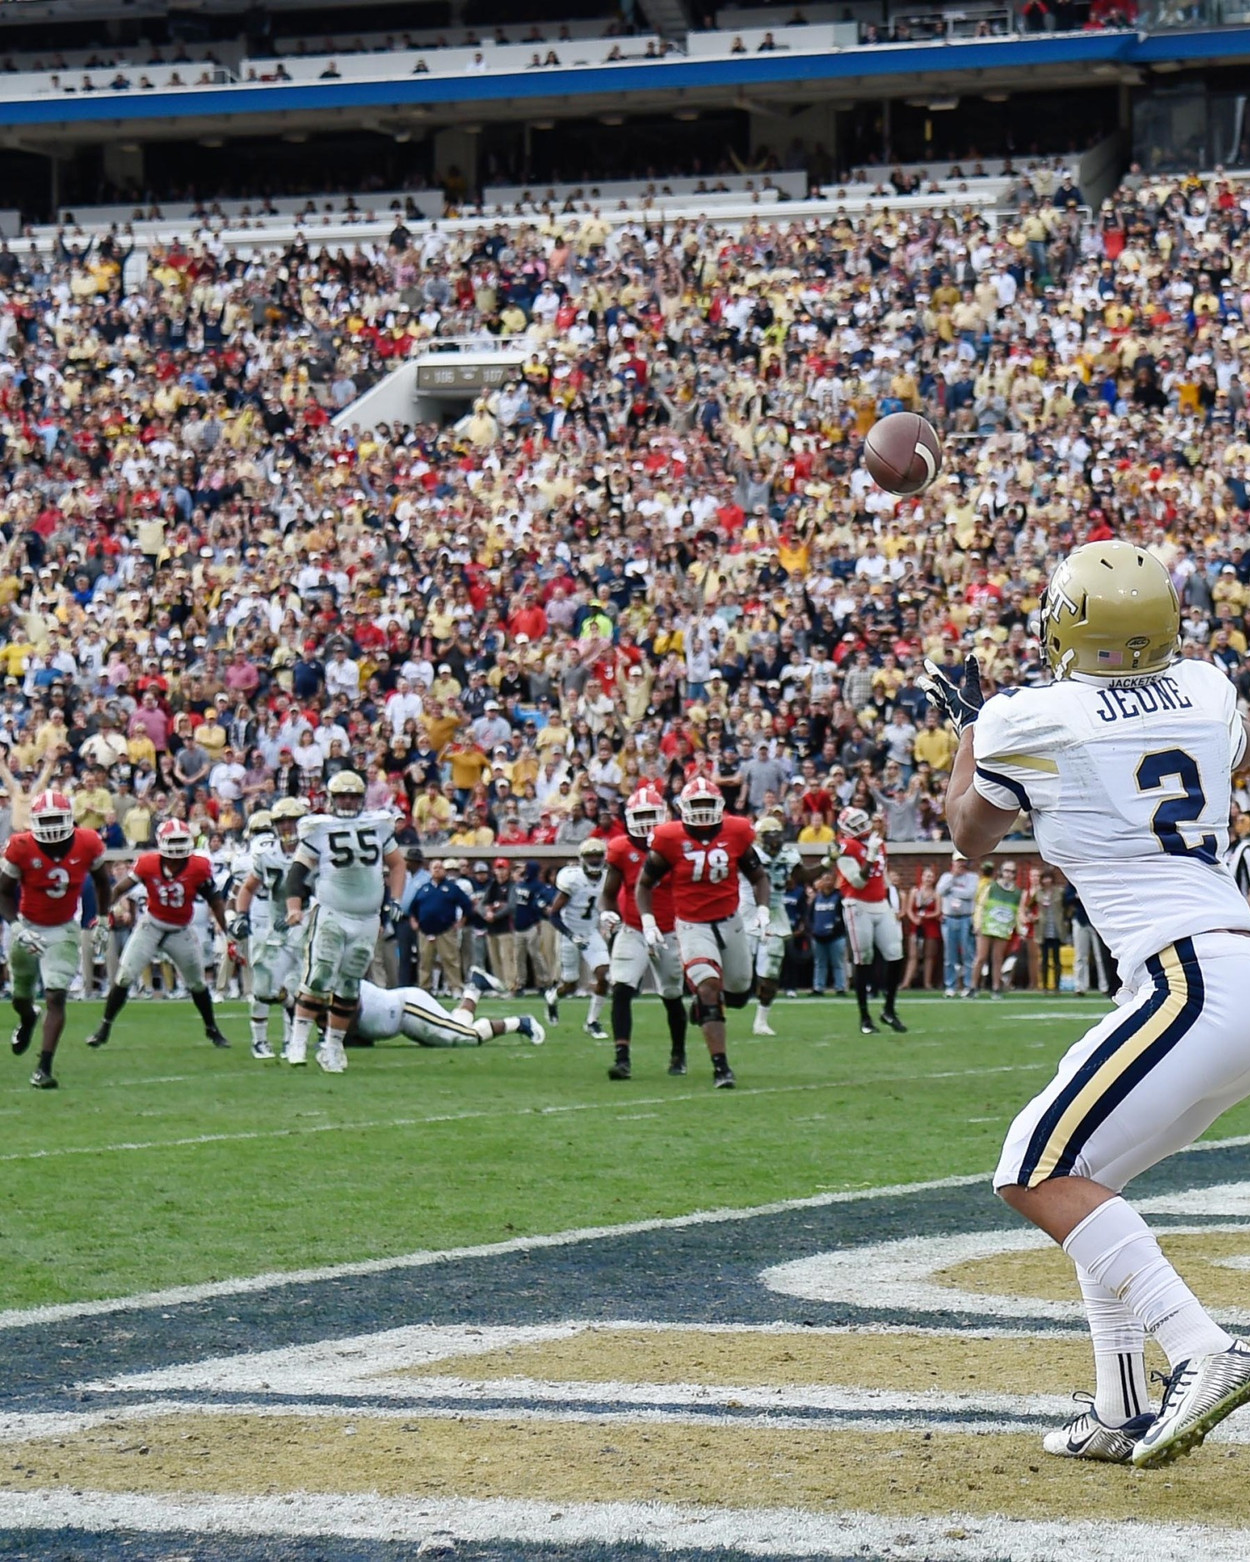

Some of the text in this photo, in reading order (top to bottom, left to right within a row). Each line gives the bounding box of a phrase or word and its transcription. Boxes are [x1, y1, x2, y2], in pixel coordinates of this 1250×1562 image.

[1129, 638, 1147, 646] ACC
[1131, 659, 1139, 669] 2
[1108, 675, 1158, 688] JACKETS
[1133, 745, 1222, 866] 2
[328, 829, 380, 869] 55
[682, 848, 729, 885] 78
[45, 868, 70, 899] 3
[158, 882, 186, 908] 13
[581, 896, 596, 920] 1
